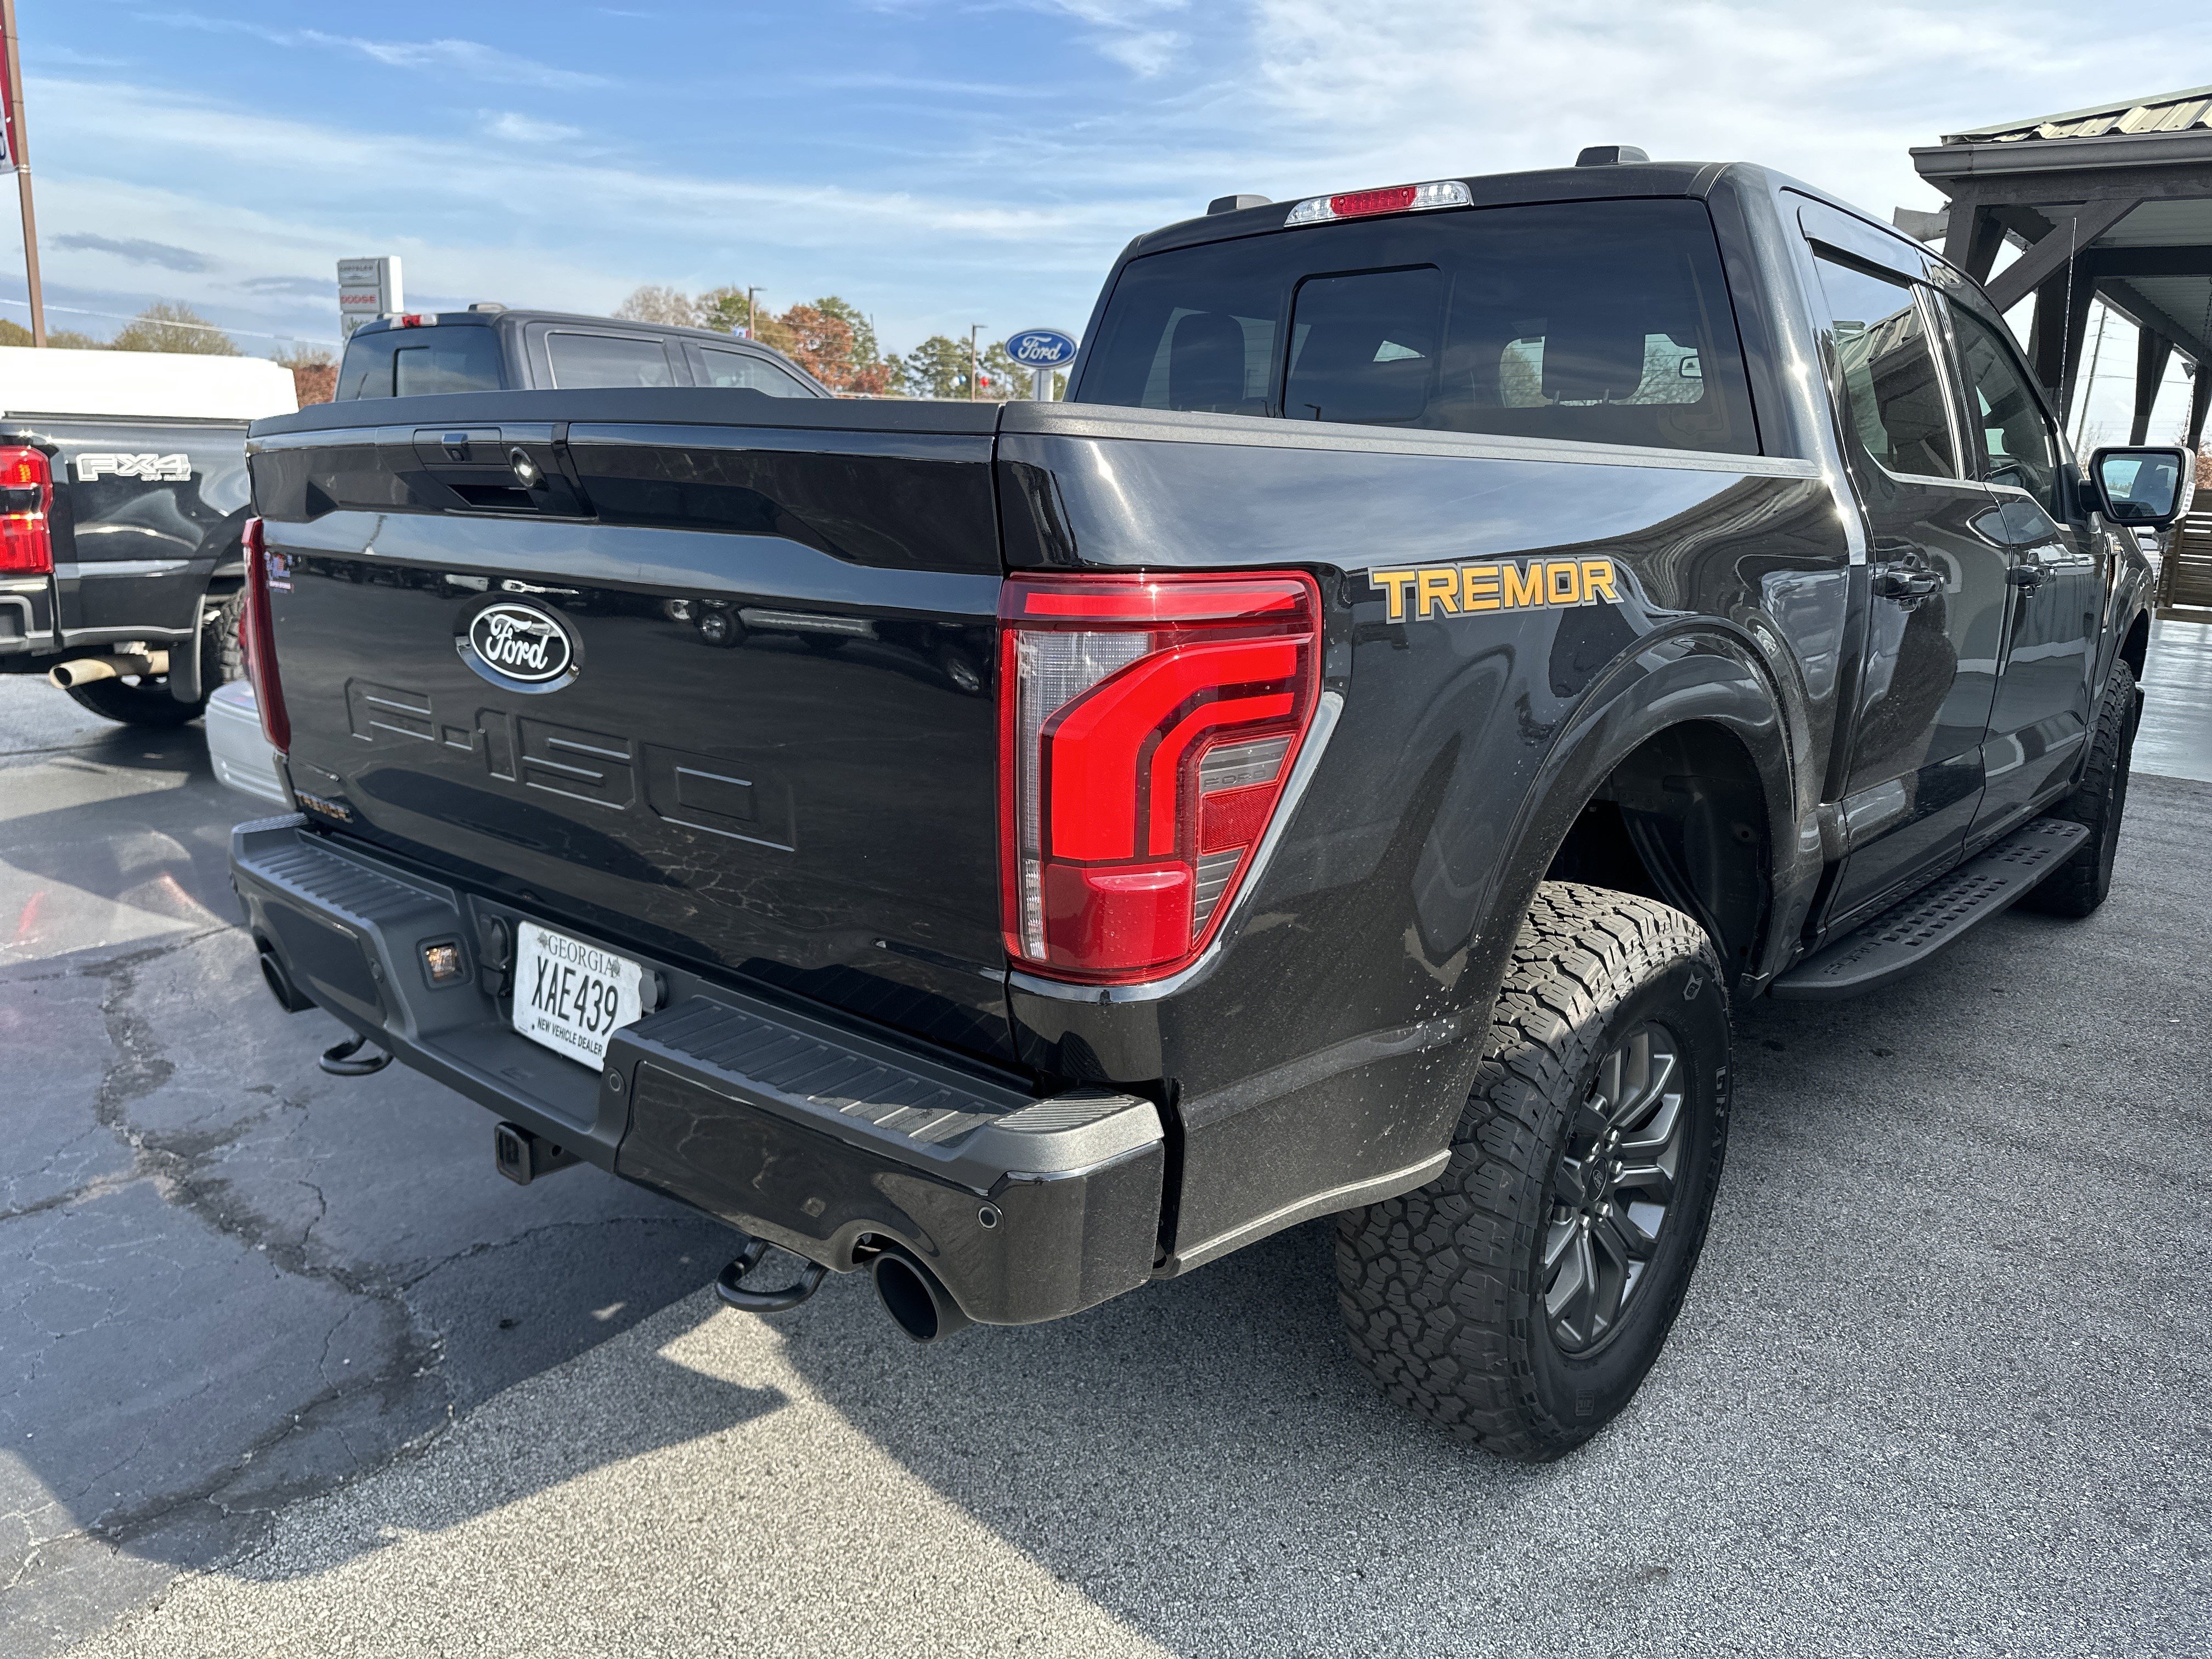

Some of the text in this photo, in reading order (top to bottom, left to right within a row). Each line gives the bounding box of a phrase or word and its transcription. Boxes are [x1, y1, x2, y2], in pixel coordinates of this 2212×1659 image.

[341, 295, 376, 304] DODGE
[1017, 336, 1063, 360] Ford
[76, 453, 191, 481] FX4
[1368, 556, 1624, 624] TREMOR
[486, 614, 549, 670] Ford
[343, 676, 795, 851] F-150
[1204, 770, 1267, 788] FORD
[548, 934, 616, 977] GEORGIA
[532, 956, 619, 1036] XAE439
[537, 1017, 603, 1057] NEW VEHICLE DEALER
